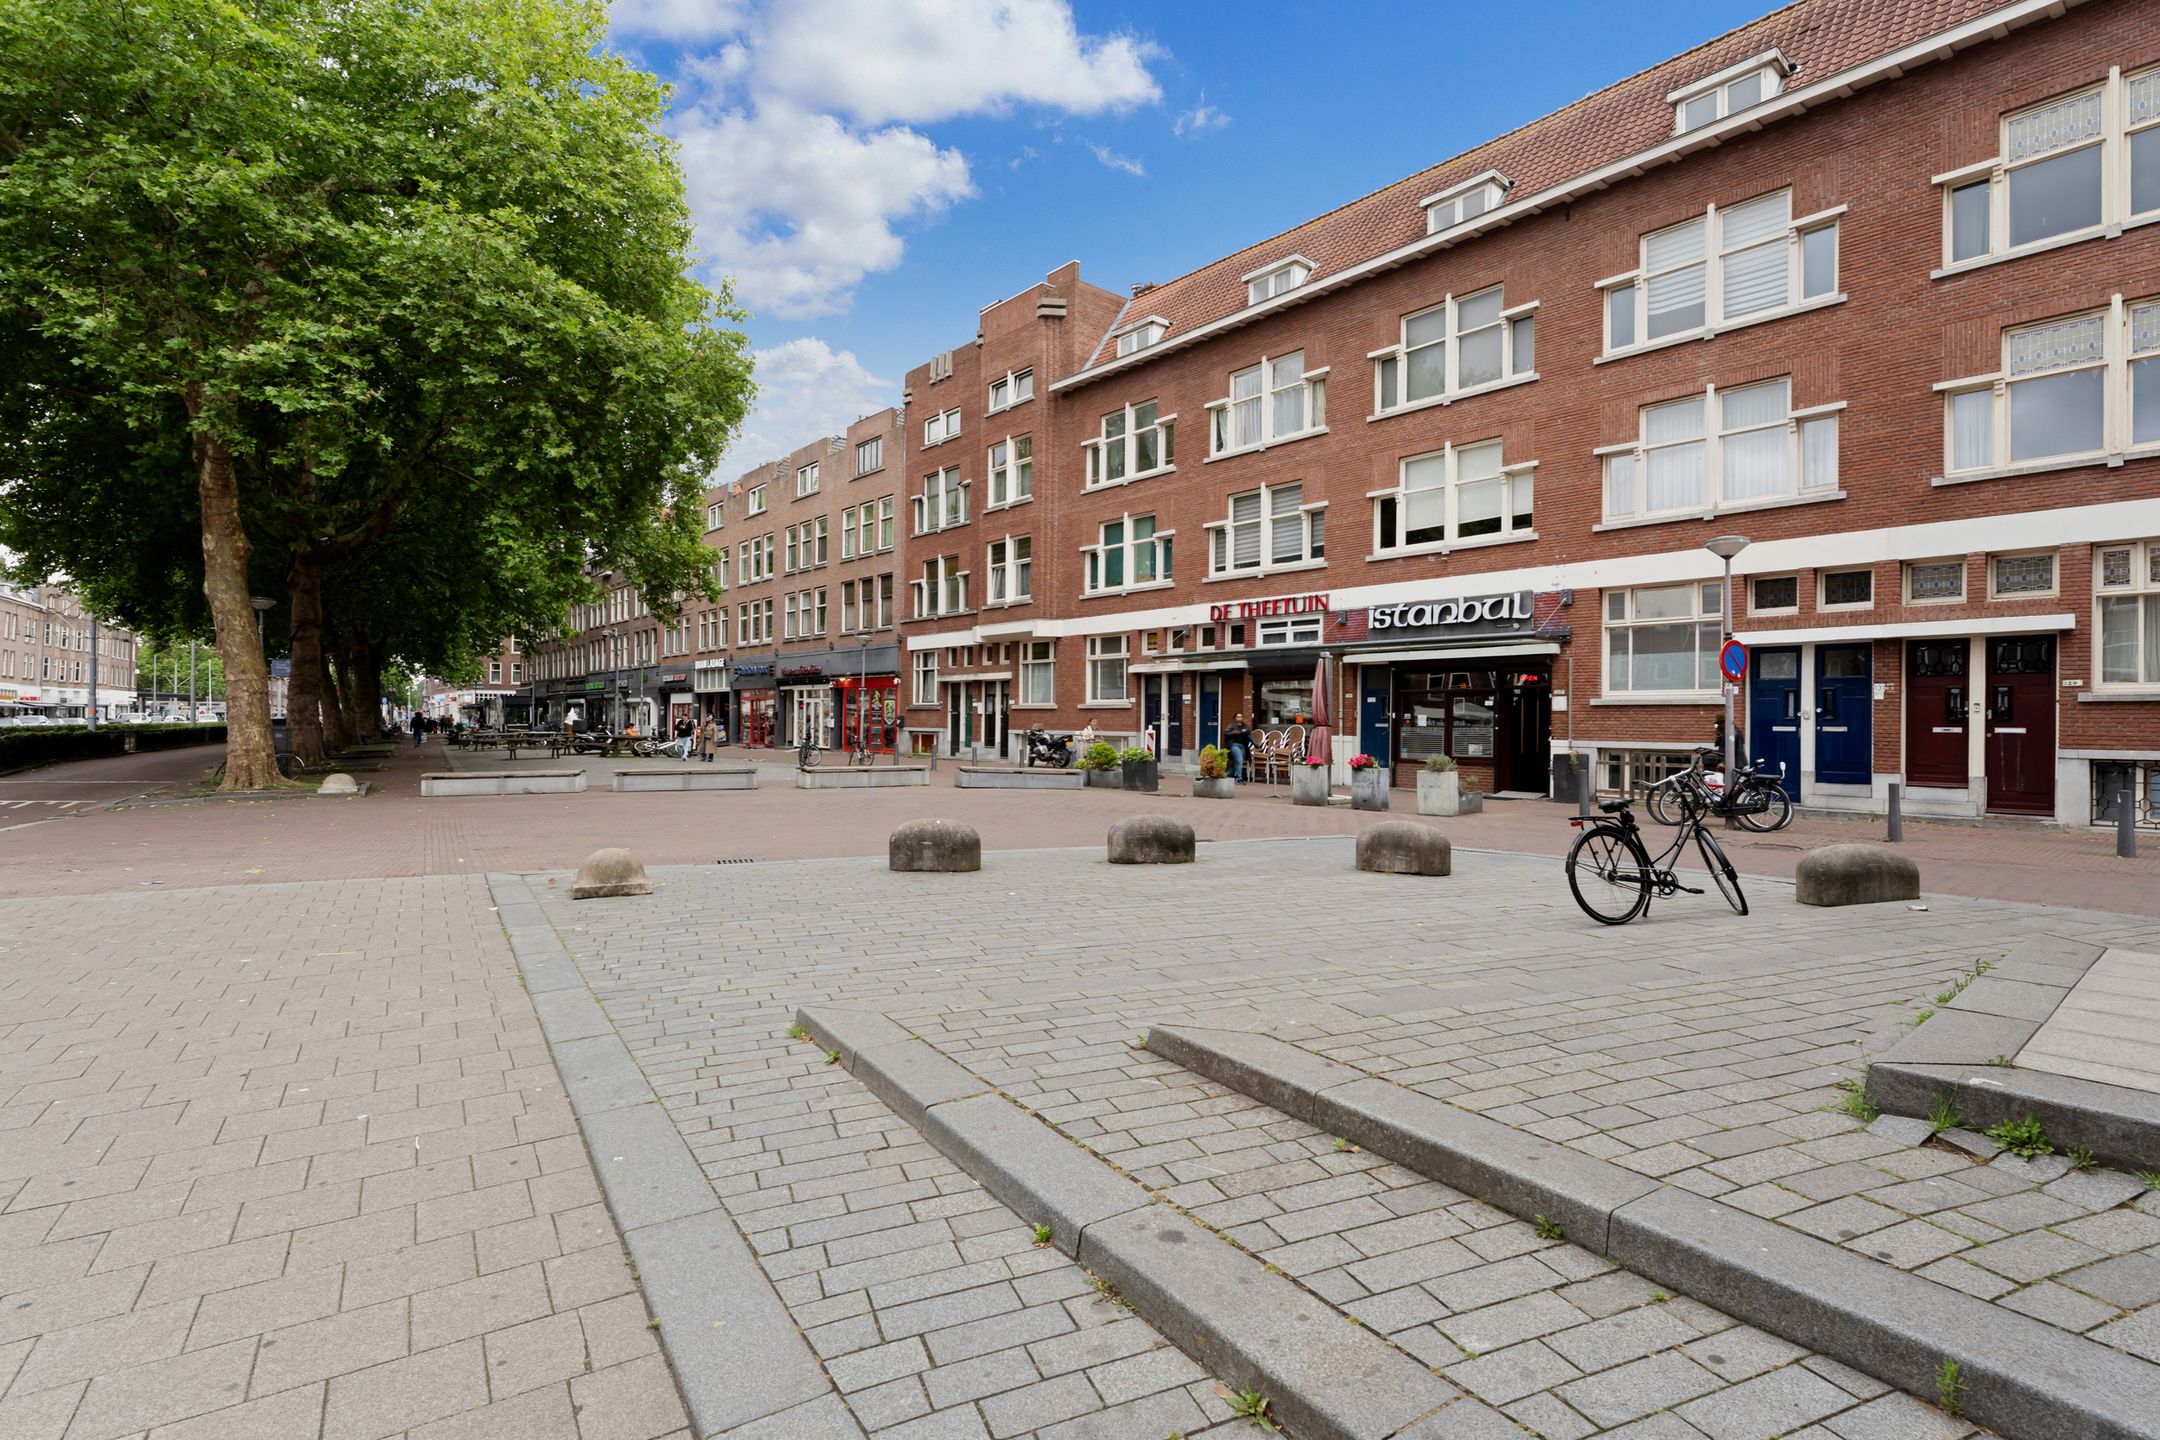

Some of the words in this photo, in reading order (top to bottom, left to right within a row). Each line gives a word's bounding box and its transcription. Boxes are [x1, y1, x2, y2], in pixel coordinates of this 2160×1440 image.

[1210, 604, 1233, 621] DE
[1238, 593, 1330, 619] THEETUIN
[1368, 592, 1532, 629] istanbul
